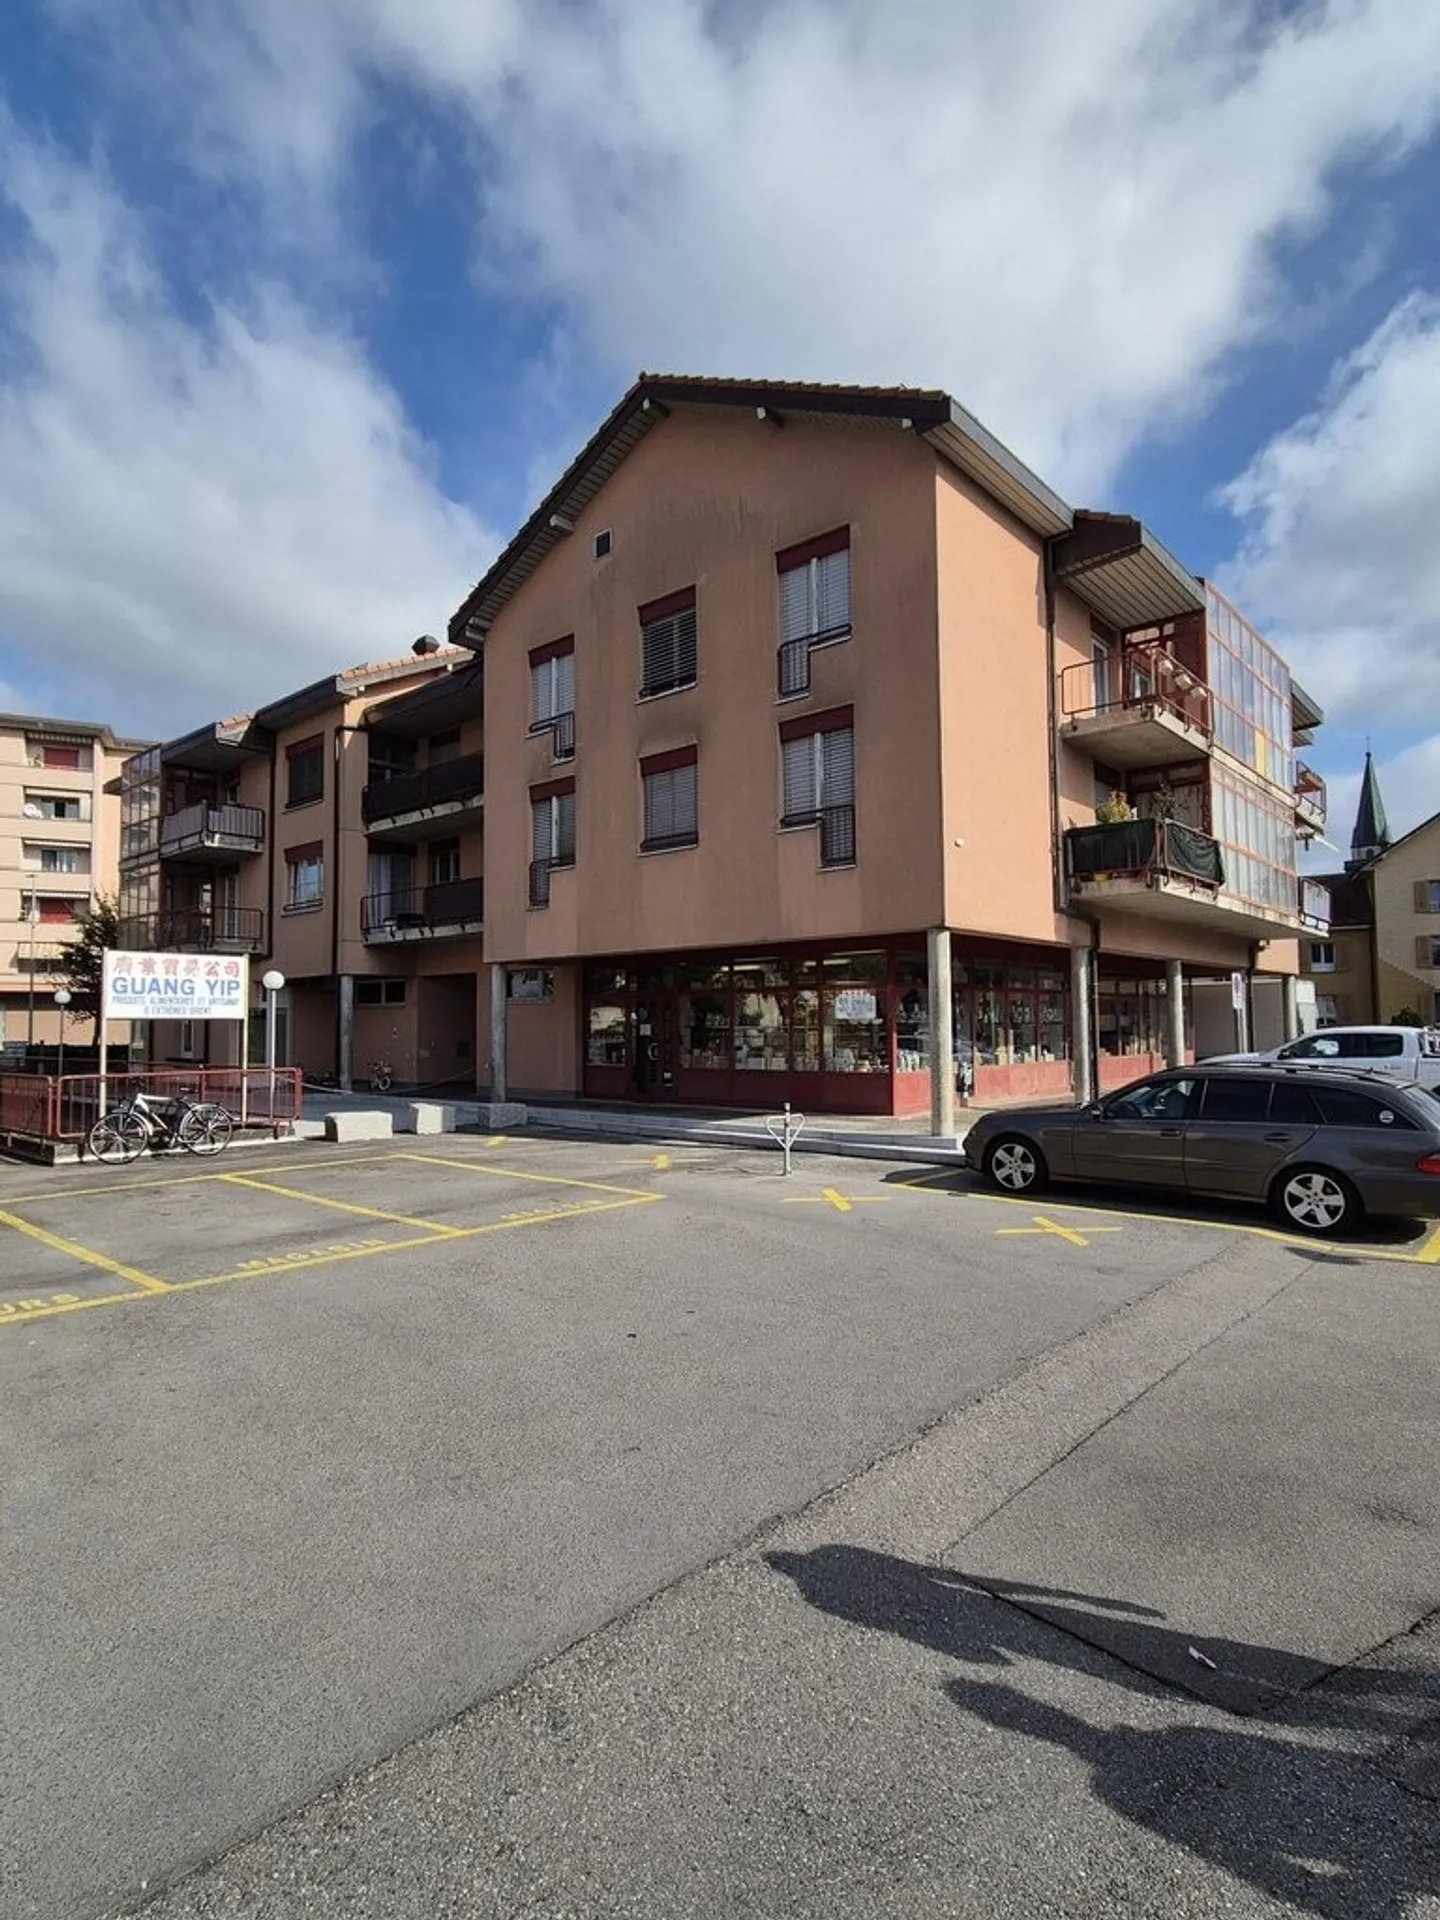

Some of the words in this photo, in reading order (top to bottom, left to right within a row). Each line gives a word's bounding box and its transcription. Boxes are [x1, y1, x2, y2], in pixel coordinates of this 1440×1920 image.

[112, 977, 195, 995] GUANG
[205, 979, 240, 996] YIP
[235, 1239, 388, 1268] MAGASIN
